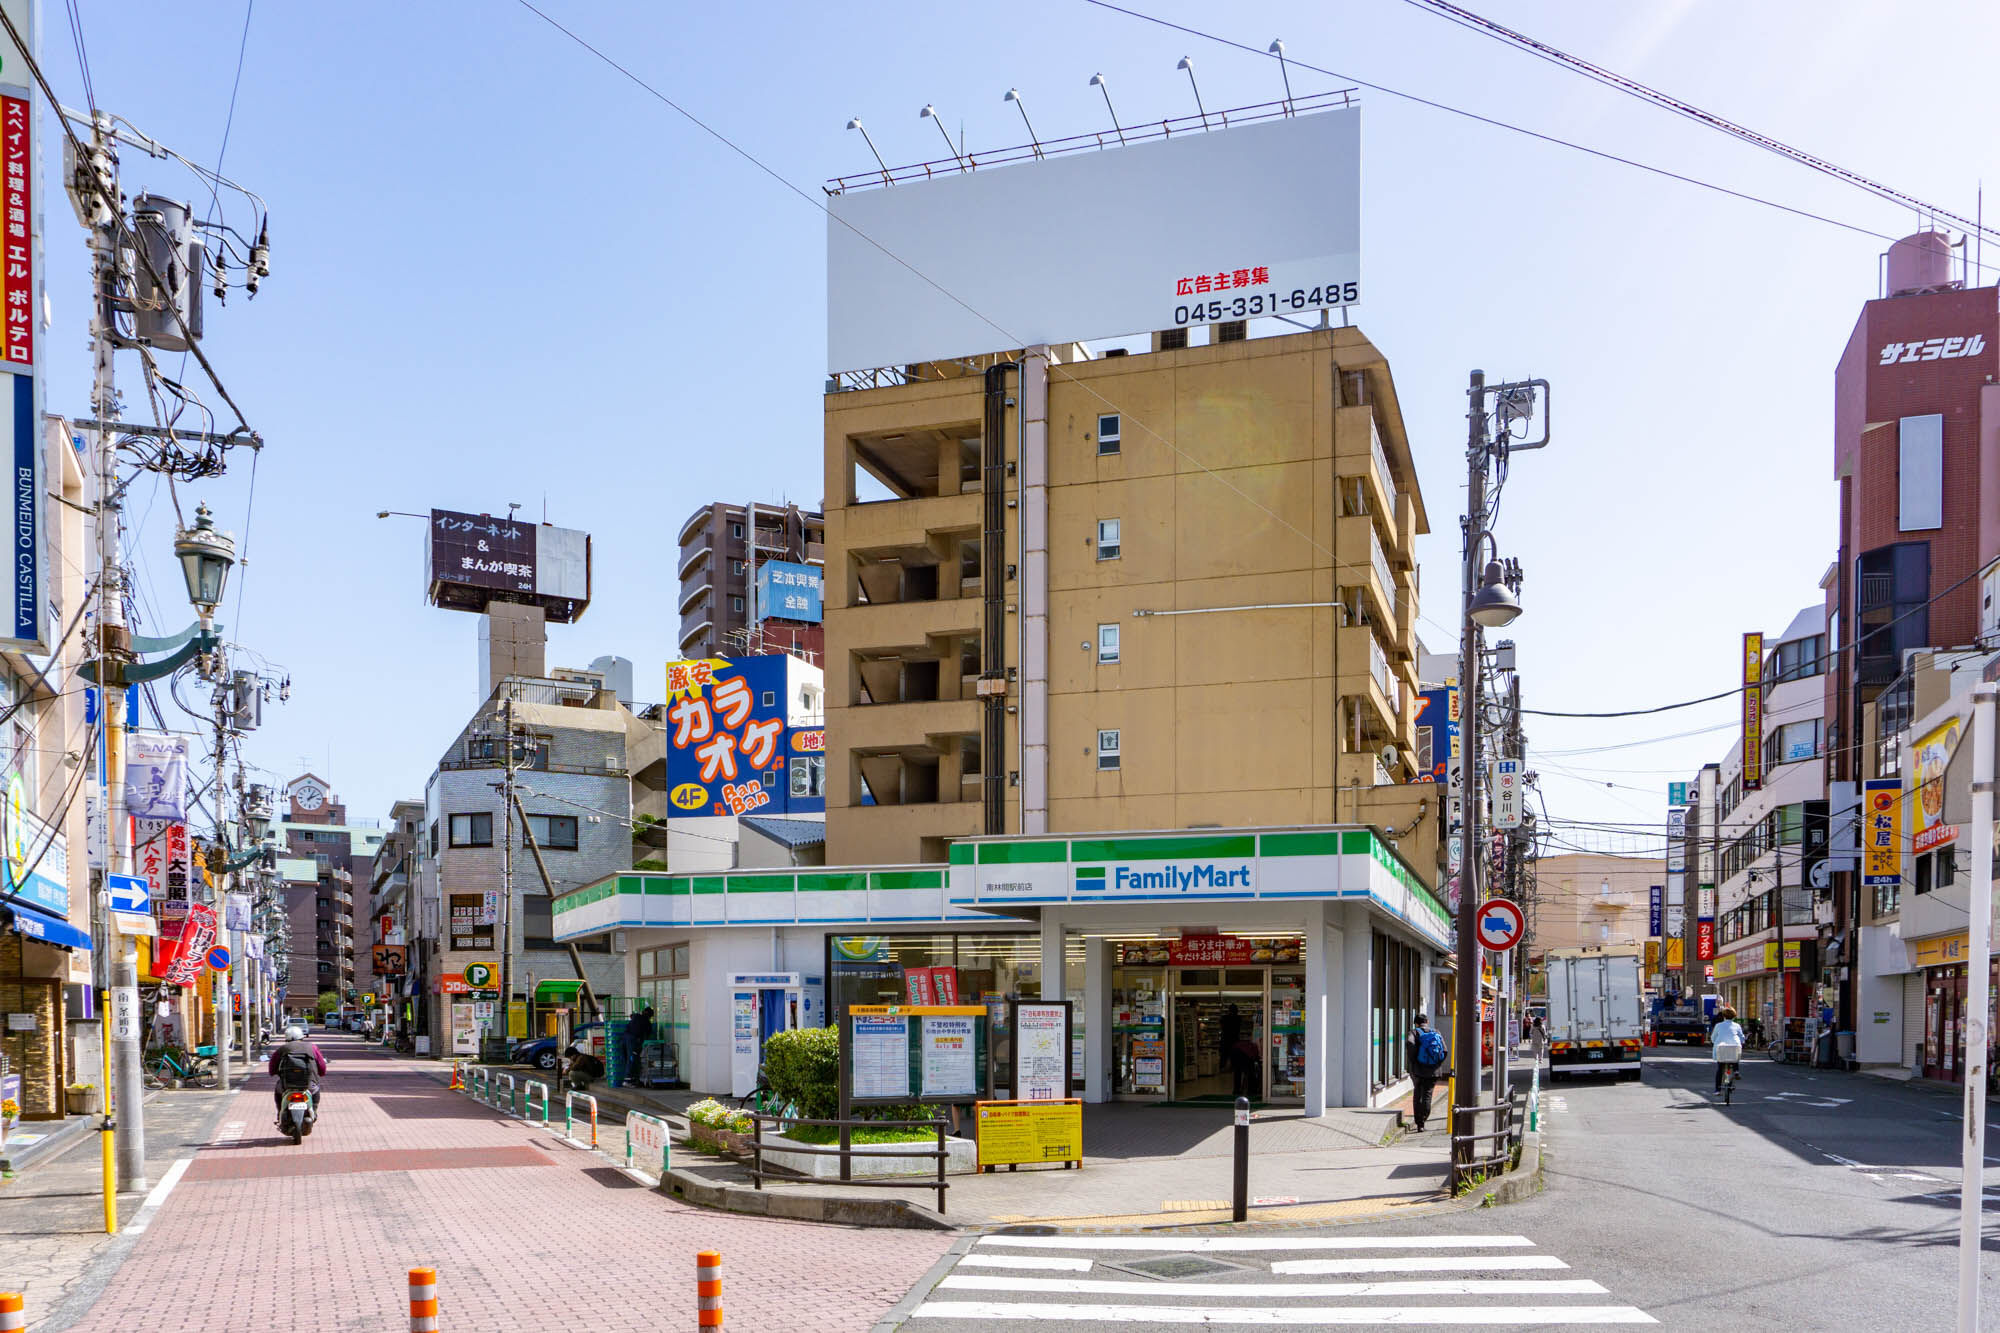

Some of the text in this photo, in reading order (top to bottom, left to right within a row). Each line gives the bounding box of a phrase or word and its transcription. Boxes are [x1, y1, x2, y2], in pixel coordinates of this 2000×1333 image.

[7, 102, 29, 362] スペイン料理&酒場 エル ポルテロ
[1176, 267, 1270, 297] 広告主募集
[1175, 281, 1358, 325] 045-331-6485
[1879, 333, 1987, 366] サエラビル
[435, 515, 522, 541] インターネット
[18, 466, 34, 627] BUNMEIDO CASTILLA
[477, 540, 490, 553] &
[461, 556, 533, 579] まんが喫茶
[771, 569, 820, 589] 芝本興業
[784, 594, 809, 611] 金融
[668, 662, 713, 692] 激安
[151, 743, 186, 755] NAS
[675, 787, 703, 808] 4F
[721, 779, 762, 805] Ban
[730, 791, 771, 816] Ban
[1501, 789, 1513, 813] 谷川
[1874, 813, 1893, 847] 松屋
[986, 882, 1033, 892] 南林間駅前店
[1115, 864, 1250, 892] FamilyMart
[1873, 876, 1893, 884] 24h
[1187, 939, 1246, 951] 極うま中華が
[1700, 924, 1711, 958] カラオケ
[1175, 950, 1227, 962] 今だけお得!
[473, 966, 488, 985] P
[855, 1015, 896, 1024] やまとニュース
